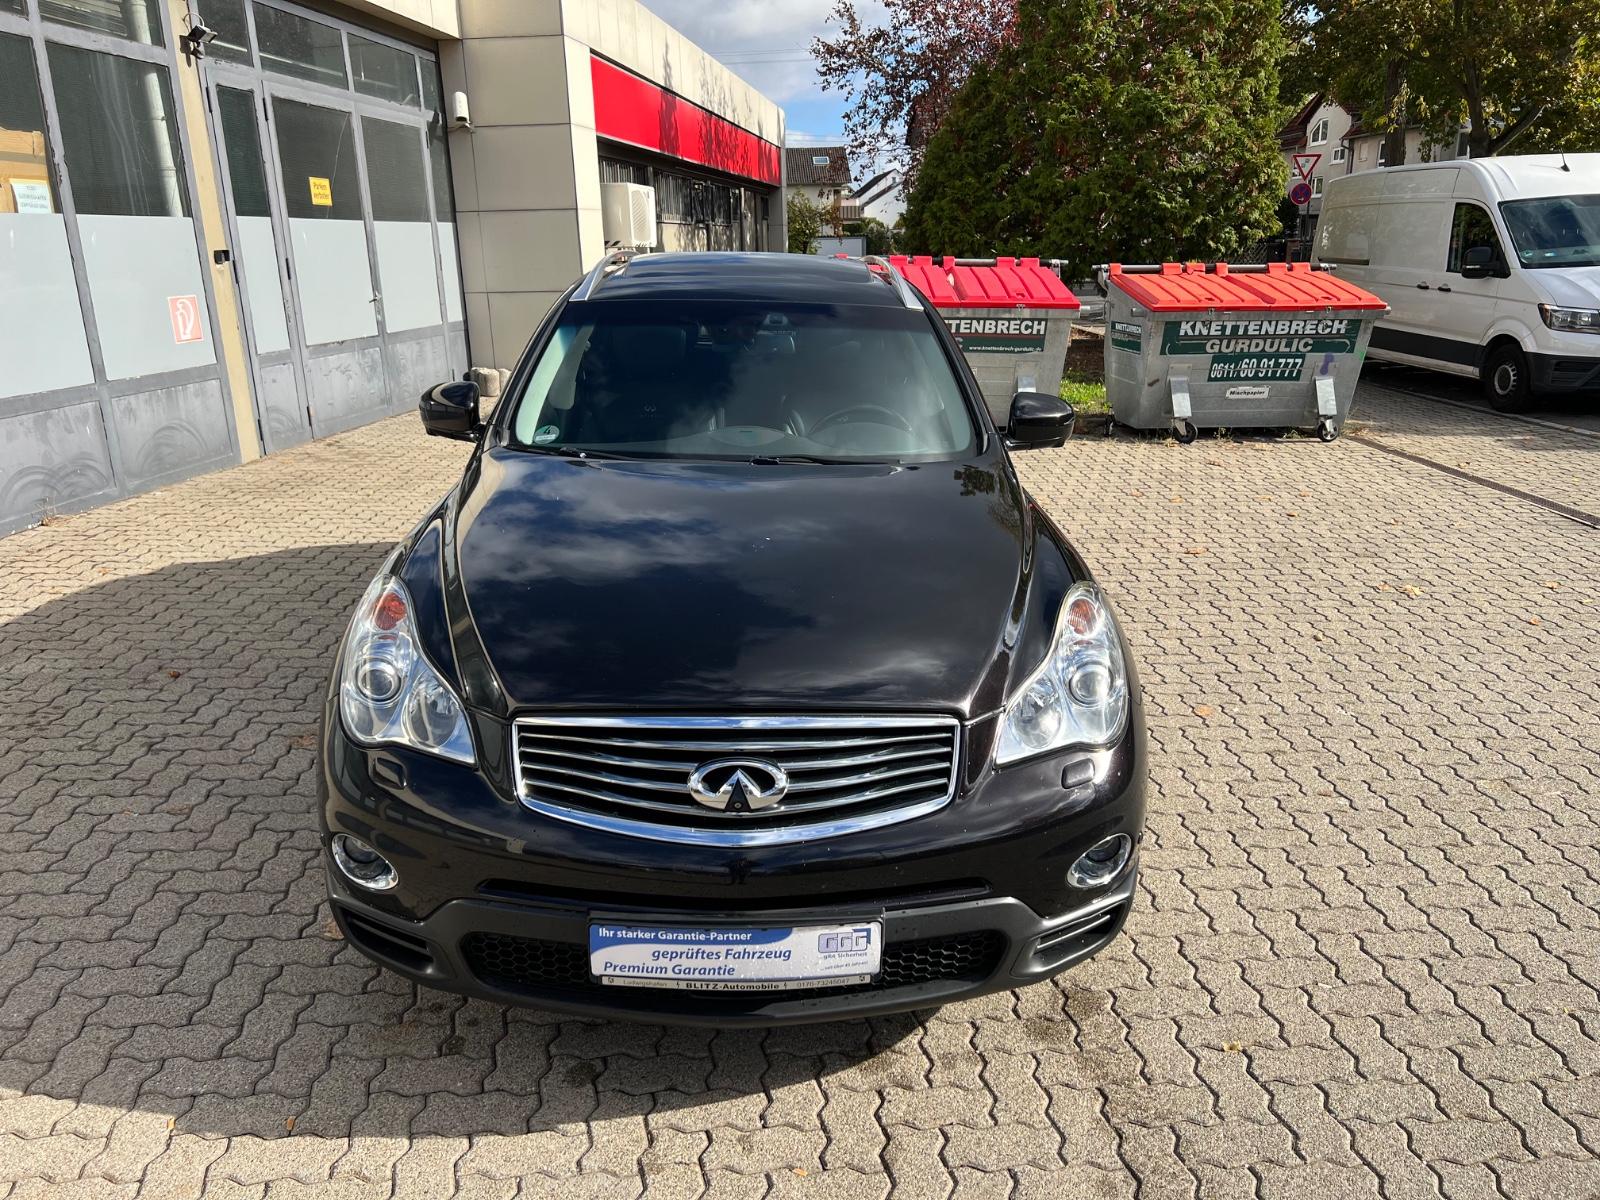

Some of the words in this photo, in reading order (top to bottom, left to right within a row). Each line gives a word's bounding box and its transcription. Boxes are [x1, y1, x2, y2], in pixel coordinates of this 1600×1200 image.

[1179, 320, 1348, 336] KNETTENBRECH
[1205, 338, 1313, 353] GURDULIC
[598, 928, 614, 937] Ihr
[617, 929, 656, 940] starker
[658, 931, 752, 941] Garantie-Partner
[651, 948, 721, 961] geprüftes
[725, 948, 792, 961] Fahrzeug
[604, 961, 668, 975] Premium
[672, 963, 736, 976] Garantie
[686, 982, 779, 990] BLITZ-Automobile
